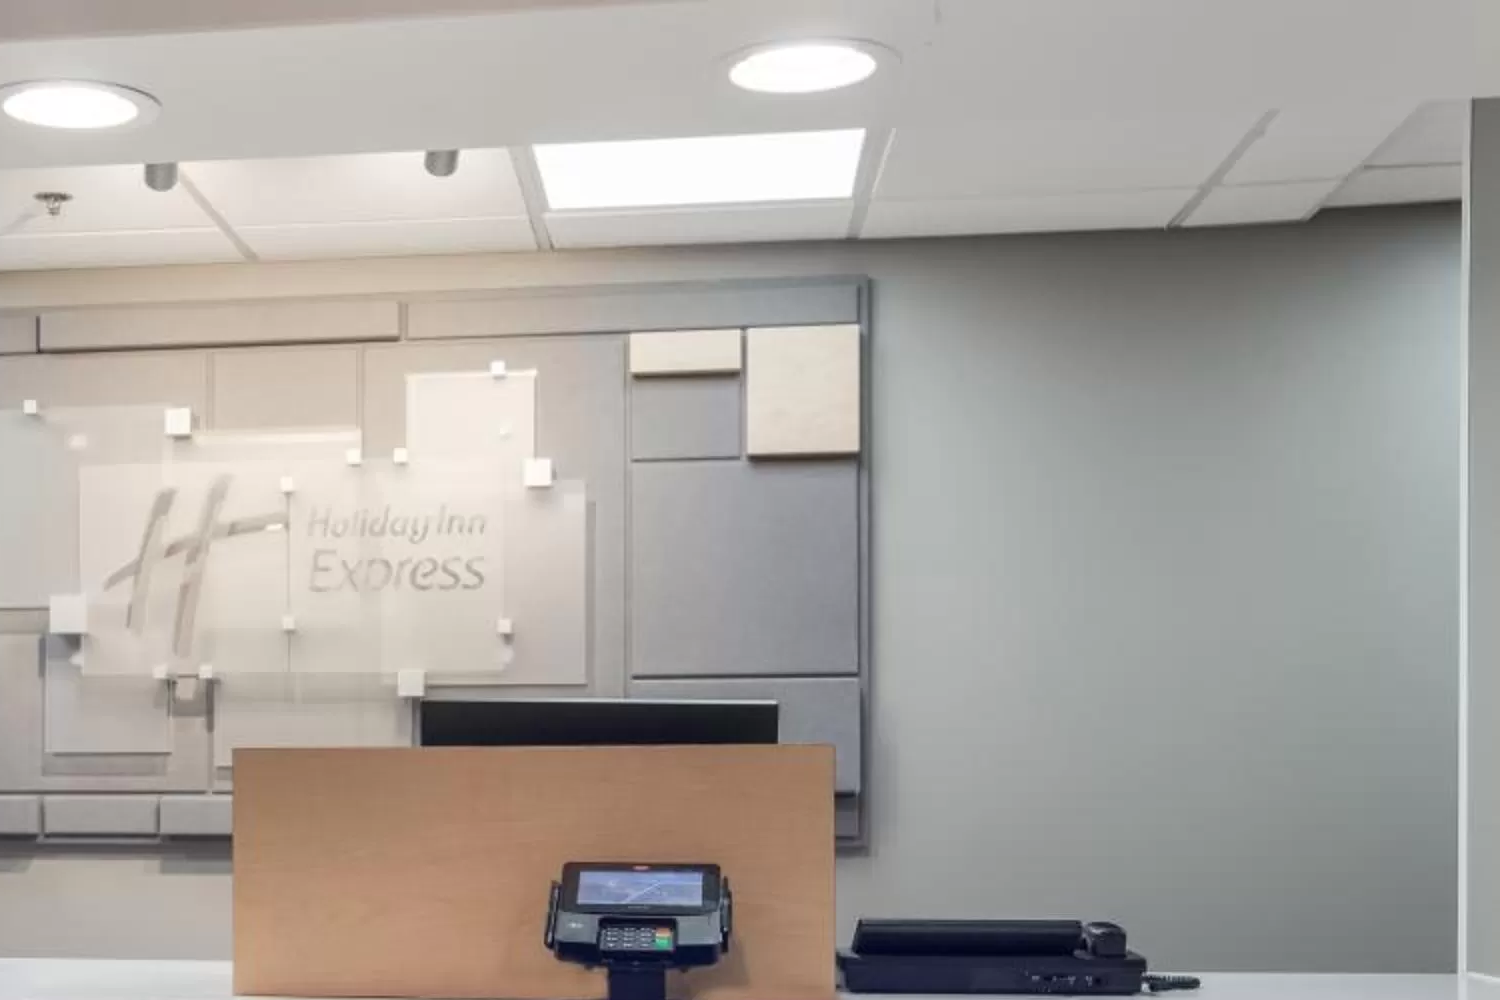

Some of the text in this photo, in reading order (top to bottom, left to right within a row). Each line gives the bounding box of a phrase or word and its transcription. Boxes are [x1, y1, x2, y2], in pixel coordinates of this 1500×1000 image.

[306, 503, 488, 544] Holiday Inn
[308, 548, 486, 593] Express
